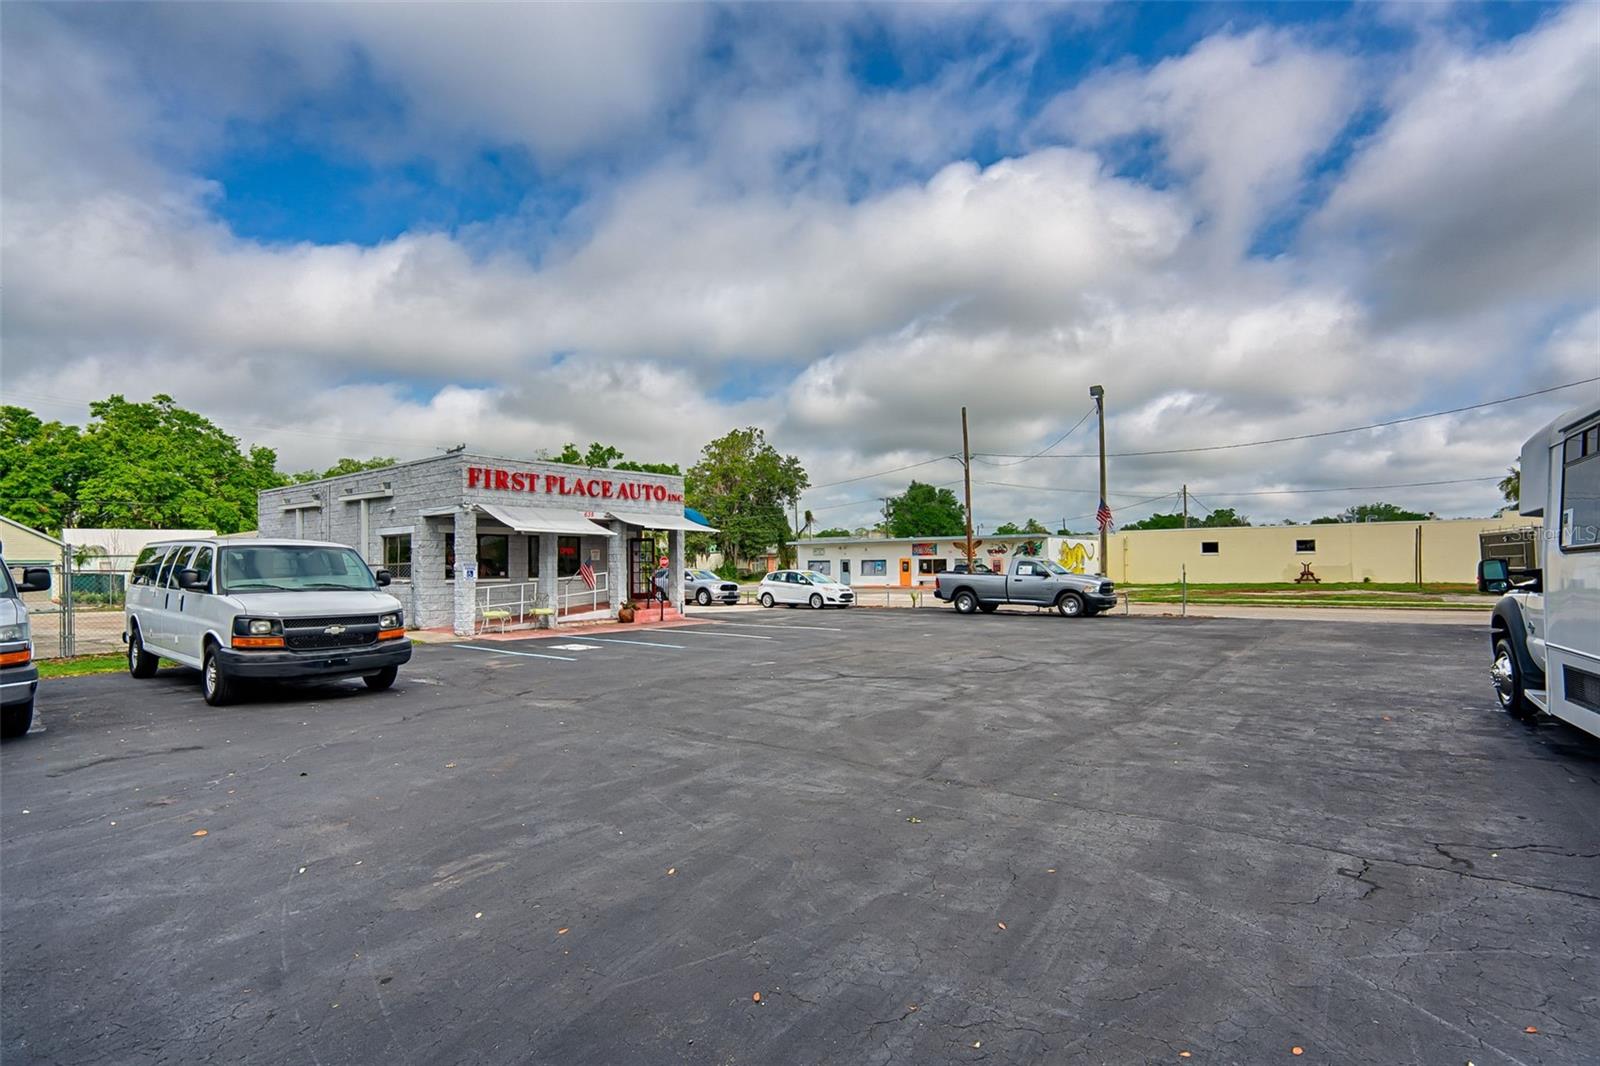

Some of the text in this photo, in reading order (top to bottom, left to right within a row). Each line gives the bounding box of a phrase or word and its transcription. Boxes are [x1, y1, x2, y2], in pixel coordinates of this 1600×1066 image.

[467, 467, 540, 493] FIRST
[545, 474, 614, 497] PLACE
[616, 482, 667, 501] AUTO
